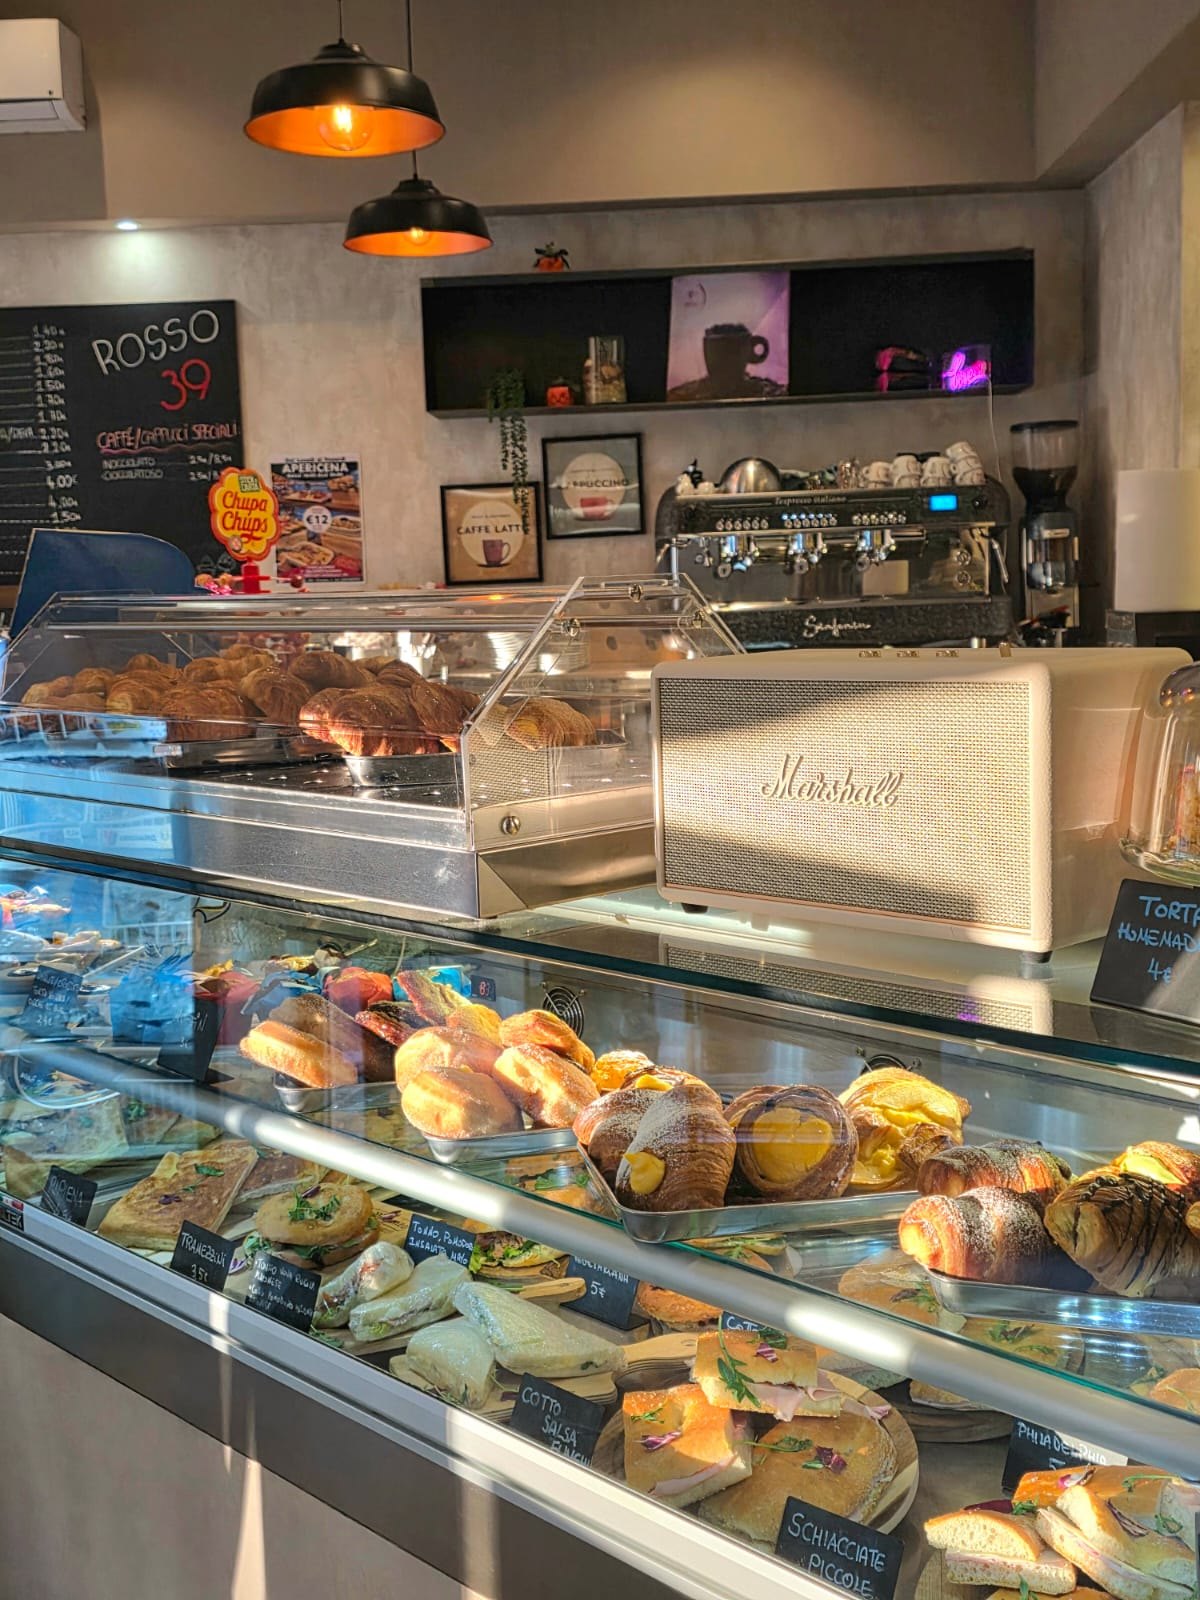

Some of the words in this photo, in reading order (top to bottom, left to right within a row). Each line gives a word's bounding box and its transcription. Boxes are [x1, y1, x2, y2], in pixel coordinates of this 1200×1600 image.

[92, 310, 219, 376] ROSSO
[160, 359, 211, 410] 39
[282, 462, 349, 474] APERICENA
[222, 491, 268, 515] Chupa
[222, 511, 269, 534] Chups
[306, 514, 329, 525] €12
[456, 524, 491, 536] CAFFE
[494, 523, 523, 534] LATT
[760, 753, 905, 808] Marshall
[521, 1386, 562, 1416] COTTO
[541, 1413, 578, 1448] SALSA
[787, 1512, 886, 1573] SCHIACCIATE
[807, 1553, 873, 1597] PICCOLE
